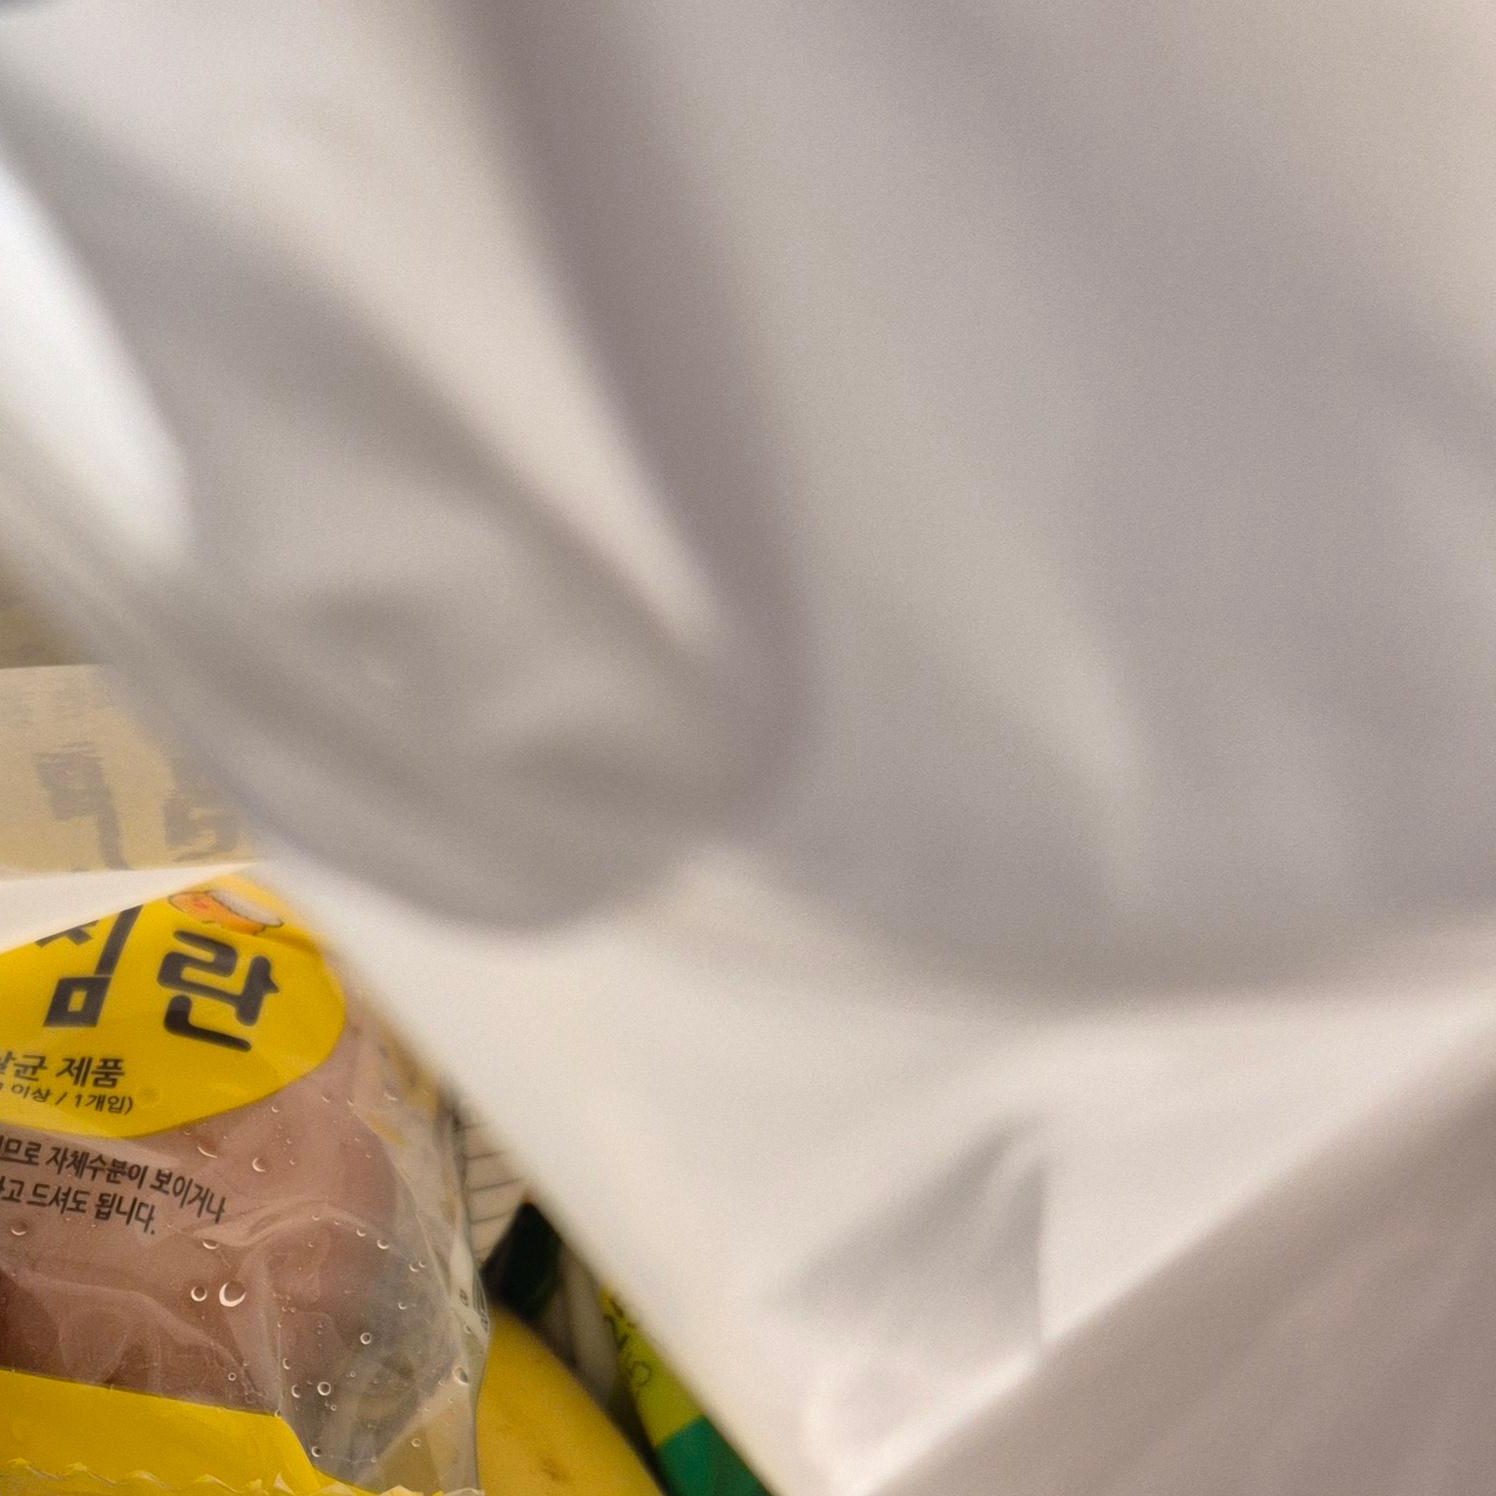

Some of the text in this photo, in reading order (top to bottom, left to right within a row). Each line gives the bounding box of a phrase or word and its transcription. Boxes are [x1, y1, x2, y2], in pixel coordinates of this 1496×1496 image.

[56, 1056, 125, 1089] 제품
[11, 1083, 53, 1103] 이상
[74, 1093, 134, 1116] 1개입)
[45, 1146, 149, 1190] 자체수분이
[150, 1168, 227, 1224] 보이거나
[26, 1182, 90, 1215] 드셔도
[94, 1192, 156, 1235] 됩니다.
